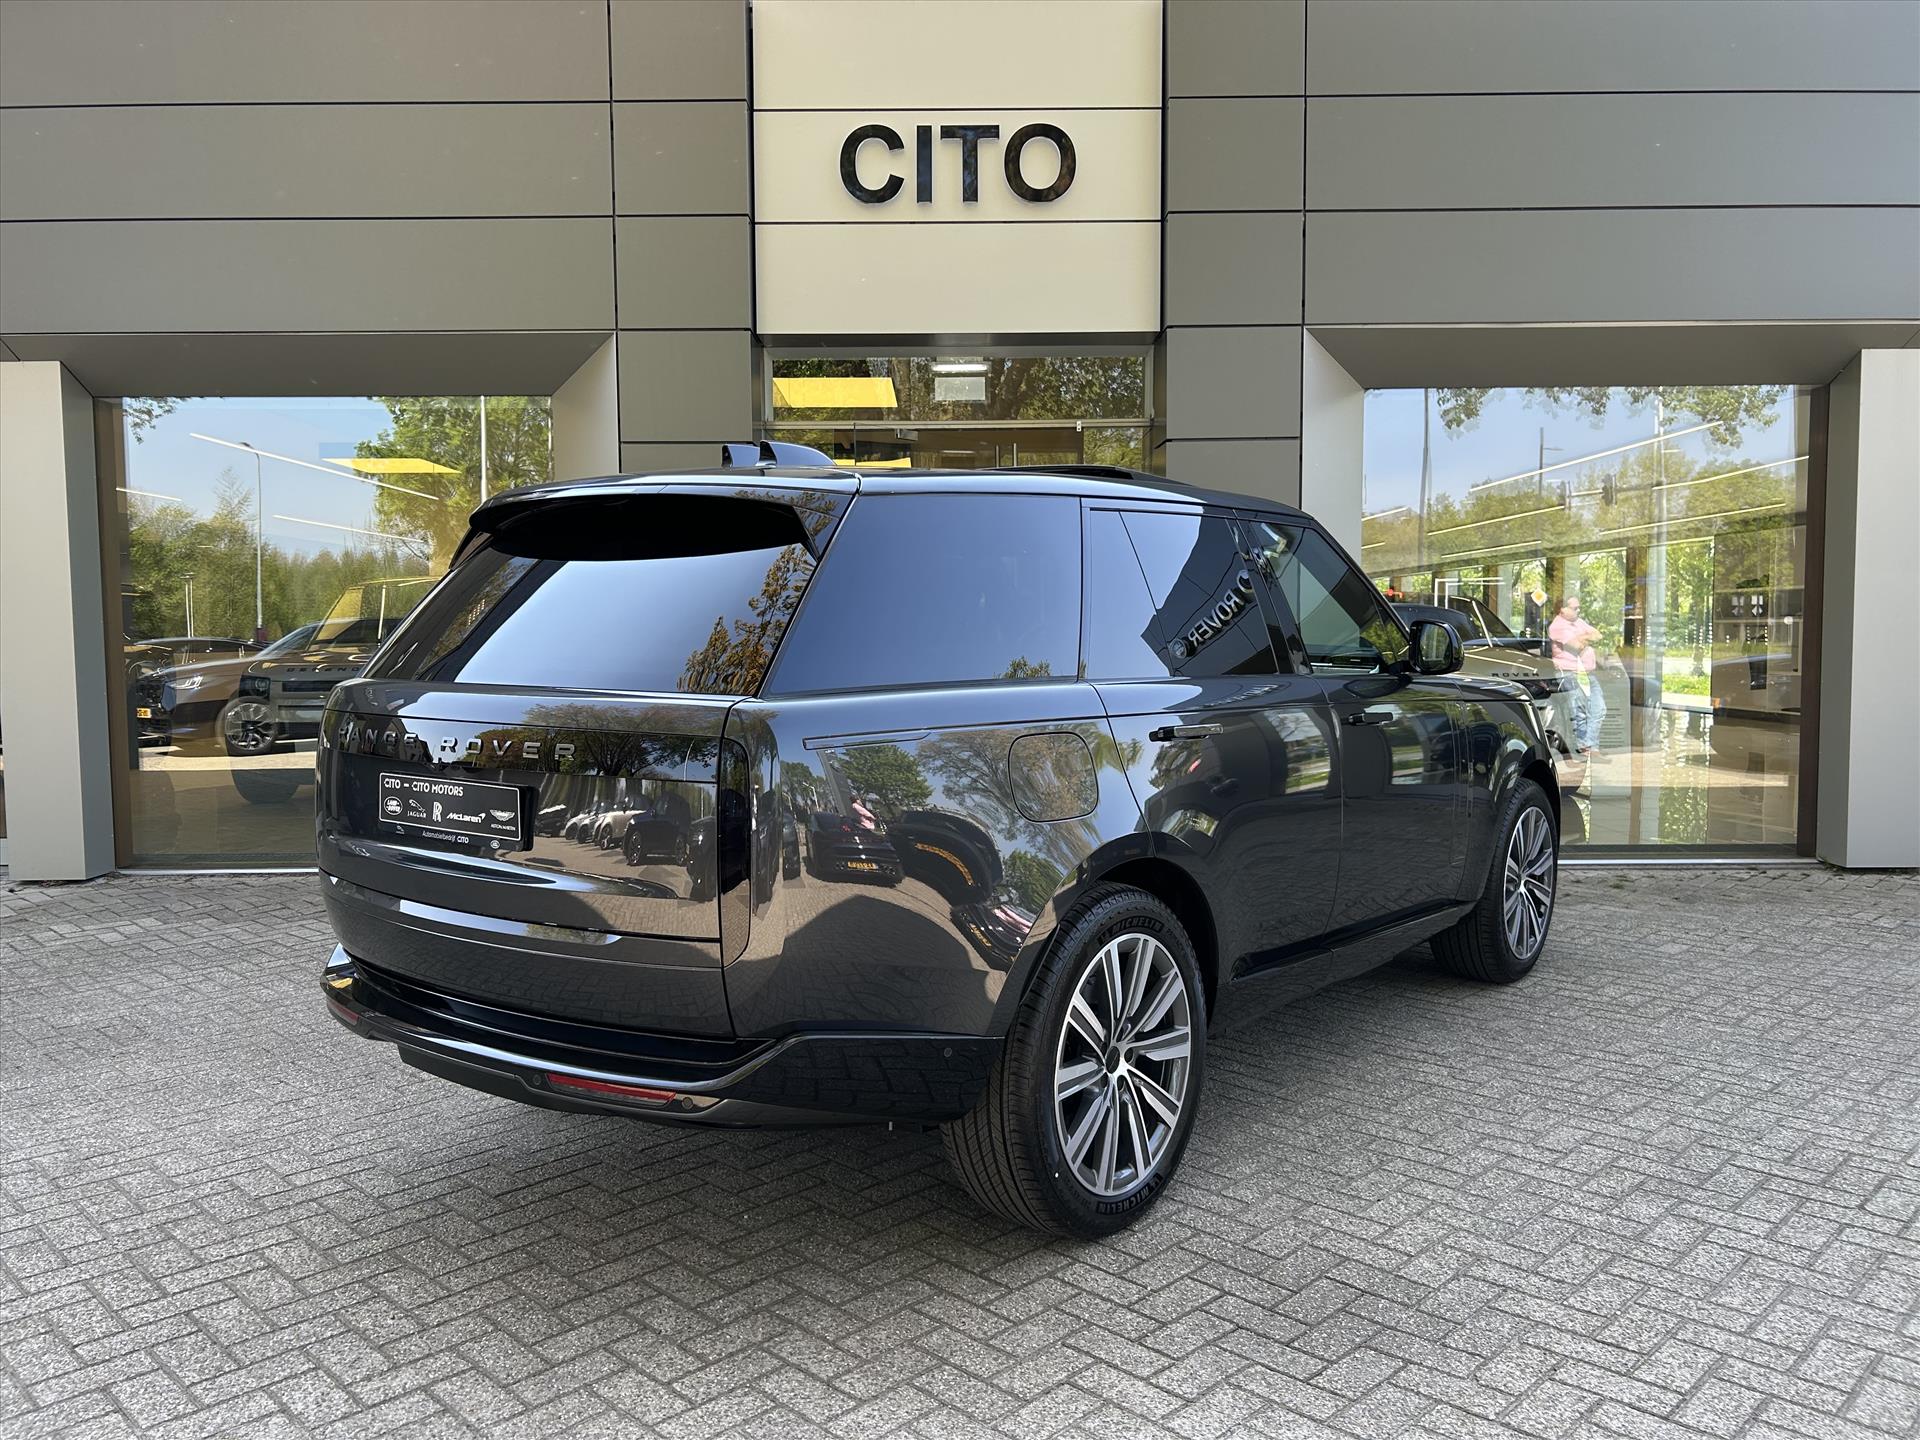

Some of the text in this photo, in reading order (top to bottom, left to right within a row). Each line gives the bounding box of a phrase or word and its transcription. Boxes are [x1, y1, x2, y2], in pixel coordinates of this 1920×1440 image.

[839, 123, 1077, 204] CITO
[338, 726, 577, 761] RANGE ROVER
[383, 778, 401, 789] CITO
[411, 781, 430, 793] CITO
[431, 783, 464, 797] MOTORS
[407, 810, 427, 819] JAGUAR
[446, 812, 482, 824] McLaren
[457, 835, 470, 844] CITO
[1110, 916, 1164, 934] MICHELIN
[1098, 1185, 1150, 1215] MICHELIN
